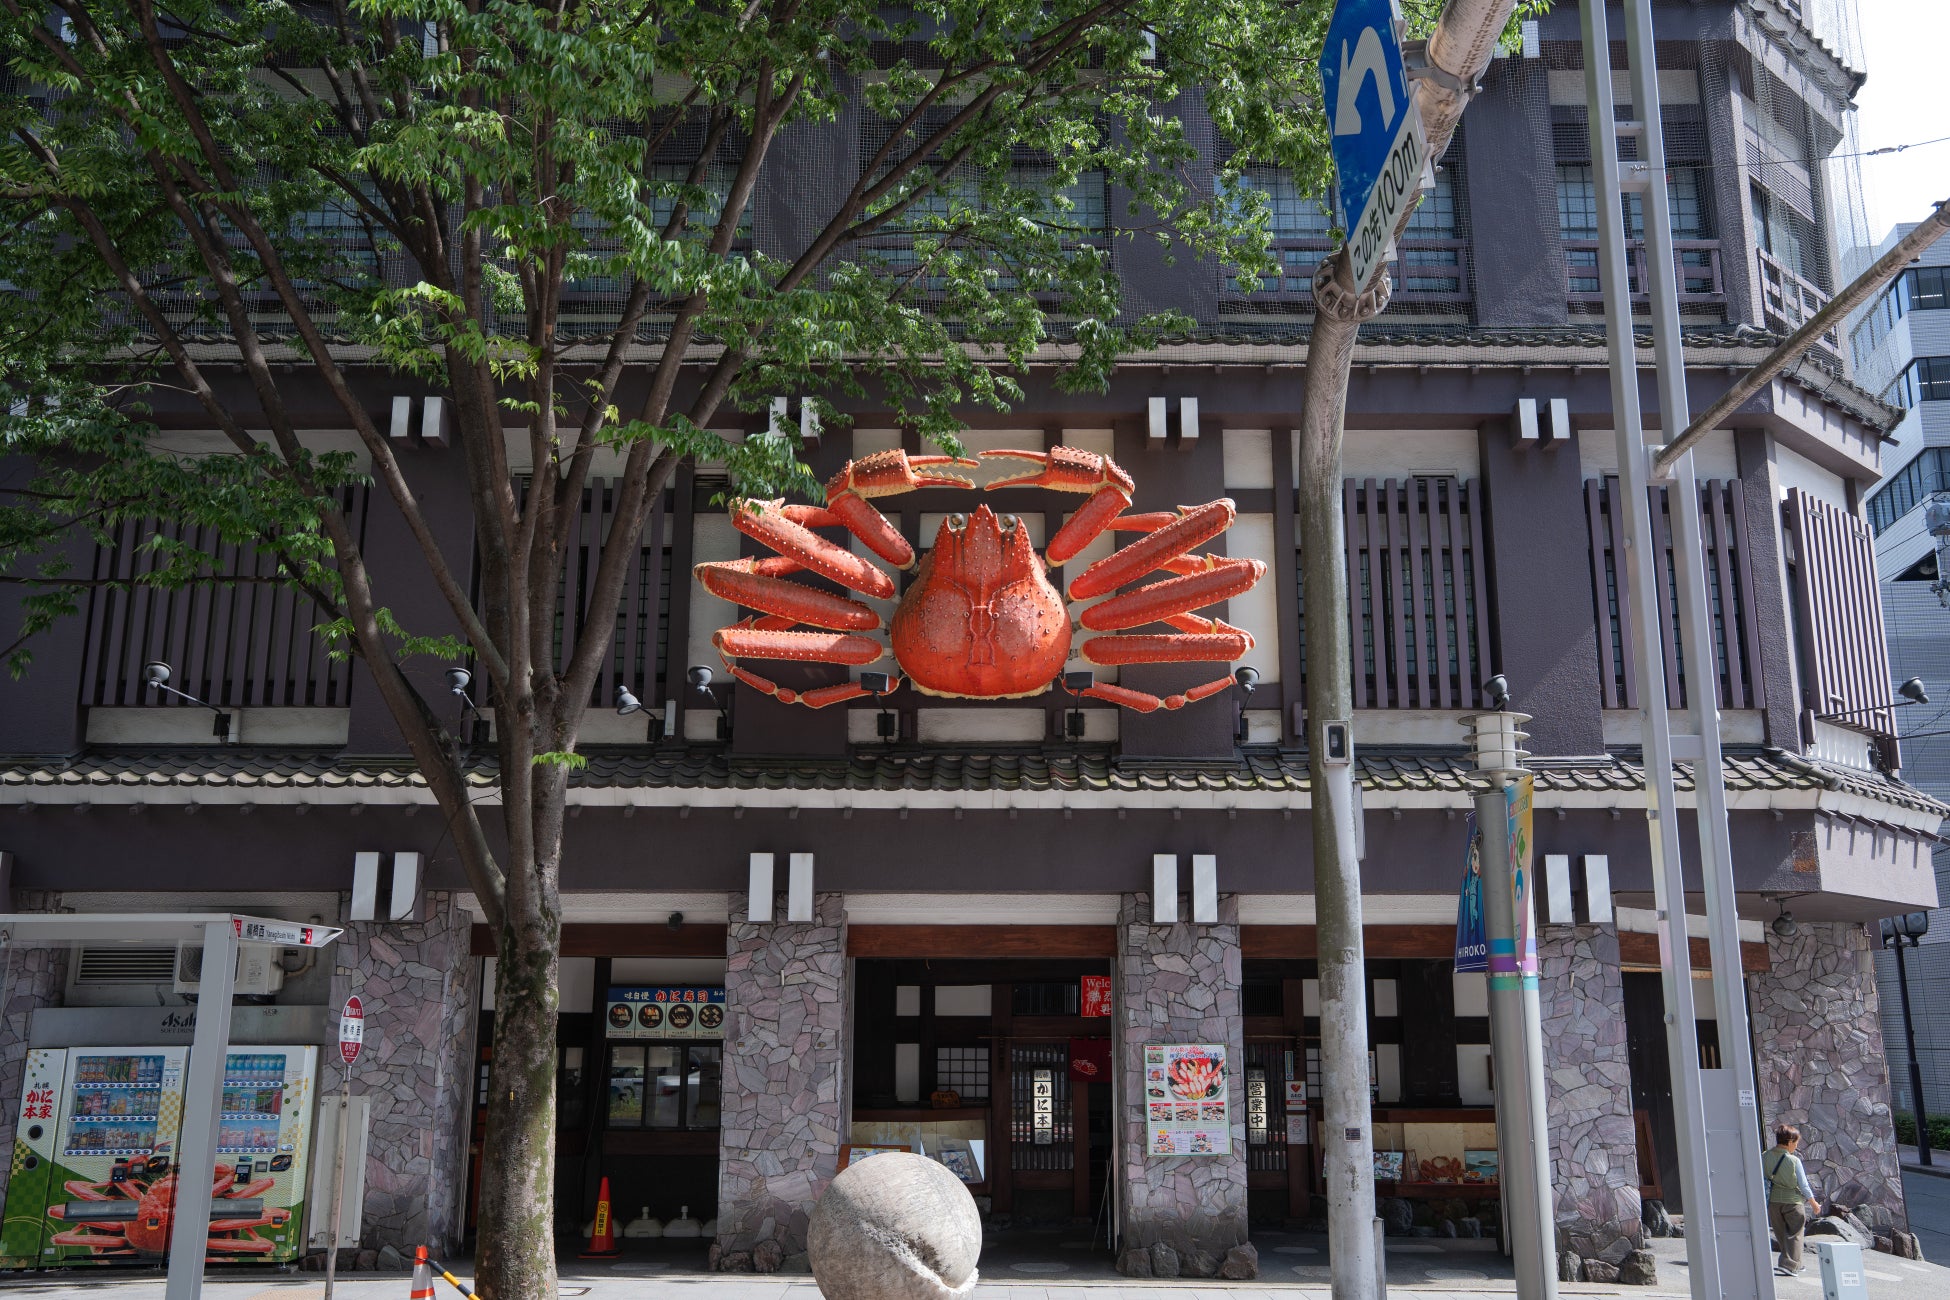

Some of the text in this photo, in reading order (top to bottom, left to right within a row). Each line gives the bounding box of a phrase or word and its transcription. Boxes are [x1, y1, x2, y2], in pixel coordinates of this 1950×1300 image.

[1353, 131, 1418, 281] この先100m
[624, 991, 650, 1001] 味自慢
[655, 989, 709, 1003] かに寿司
[26, 1089, 54, 1104] かに
[1249, 1082, 1264, 1127] 営業中
[23, 1104, 53, 1120] 本家
[1036, 1083, 1050, 1143] かに本家
